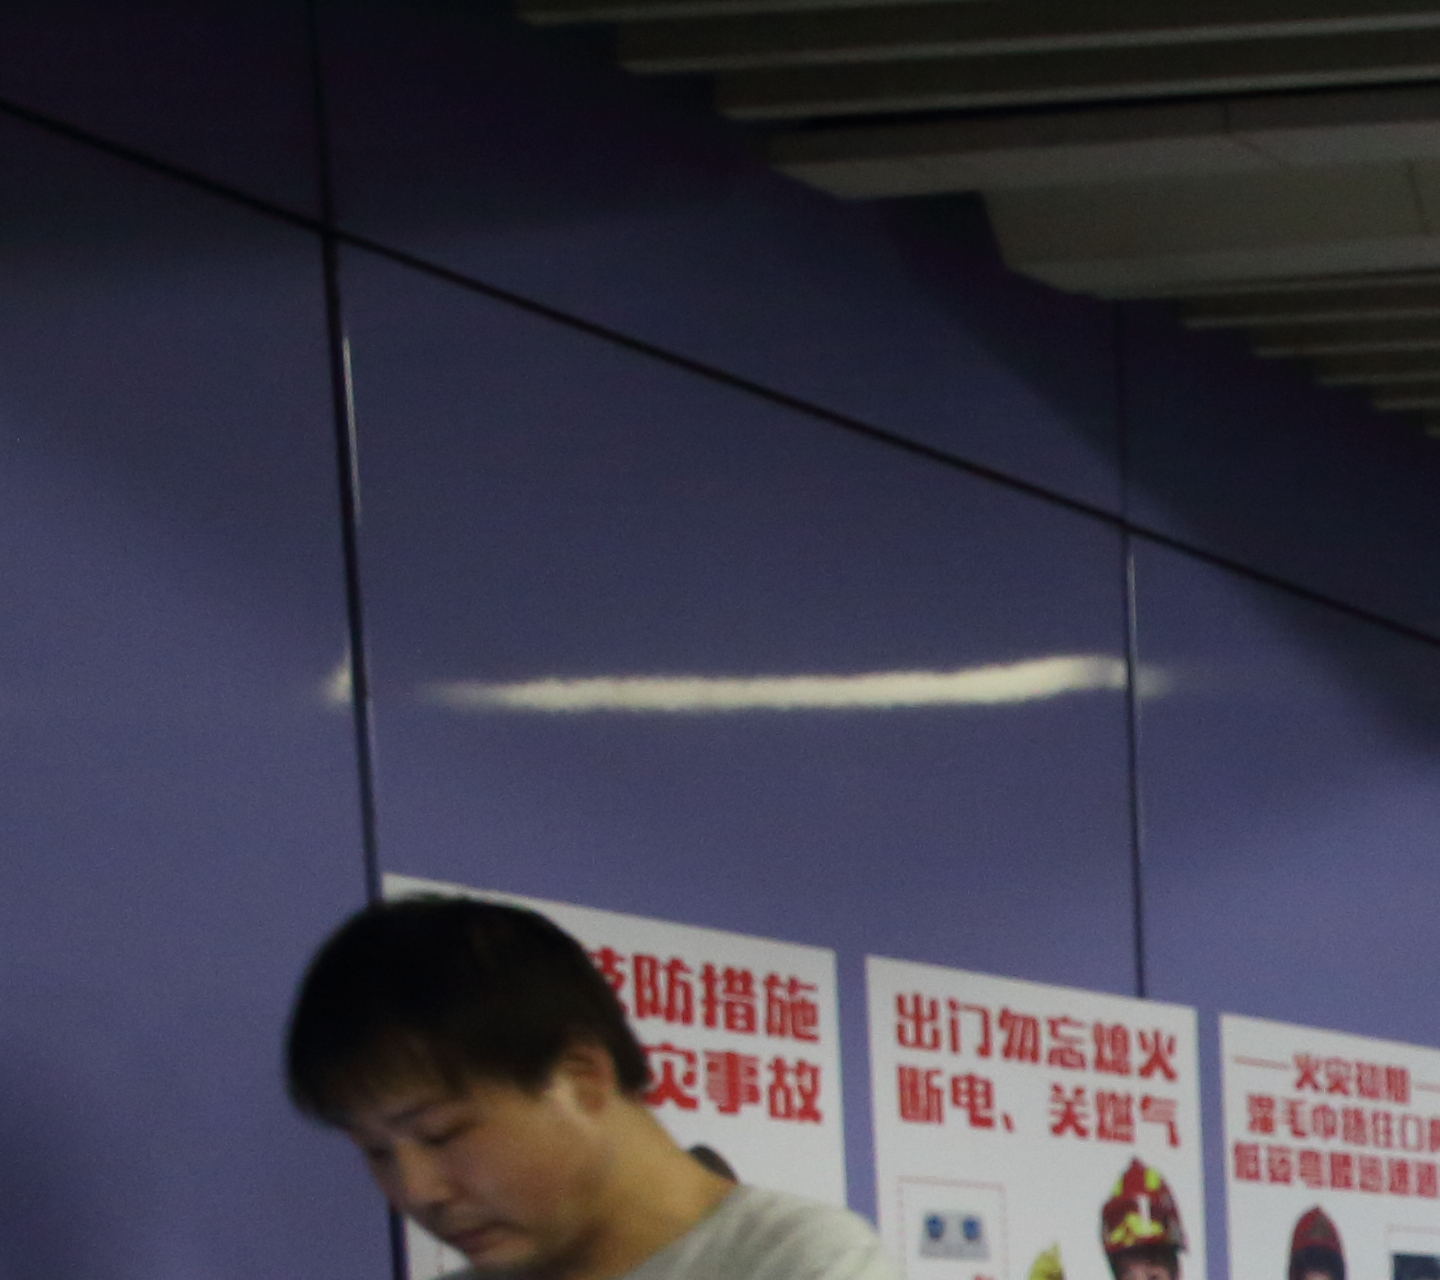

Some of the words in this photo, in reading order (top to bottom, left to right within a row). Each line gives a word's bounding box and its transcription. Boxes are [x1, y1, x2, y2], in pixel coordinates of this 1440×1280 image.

[896, 993, 1177, 1082] 出门勿忘熄火
